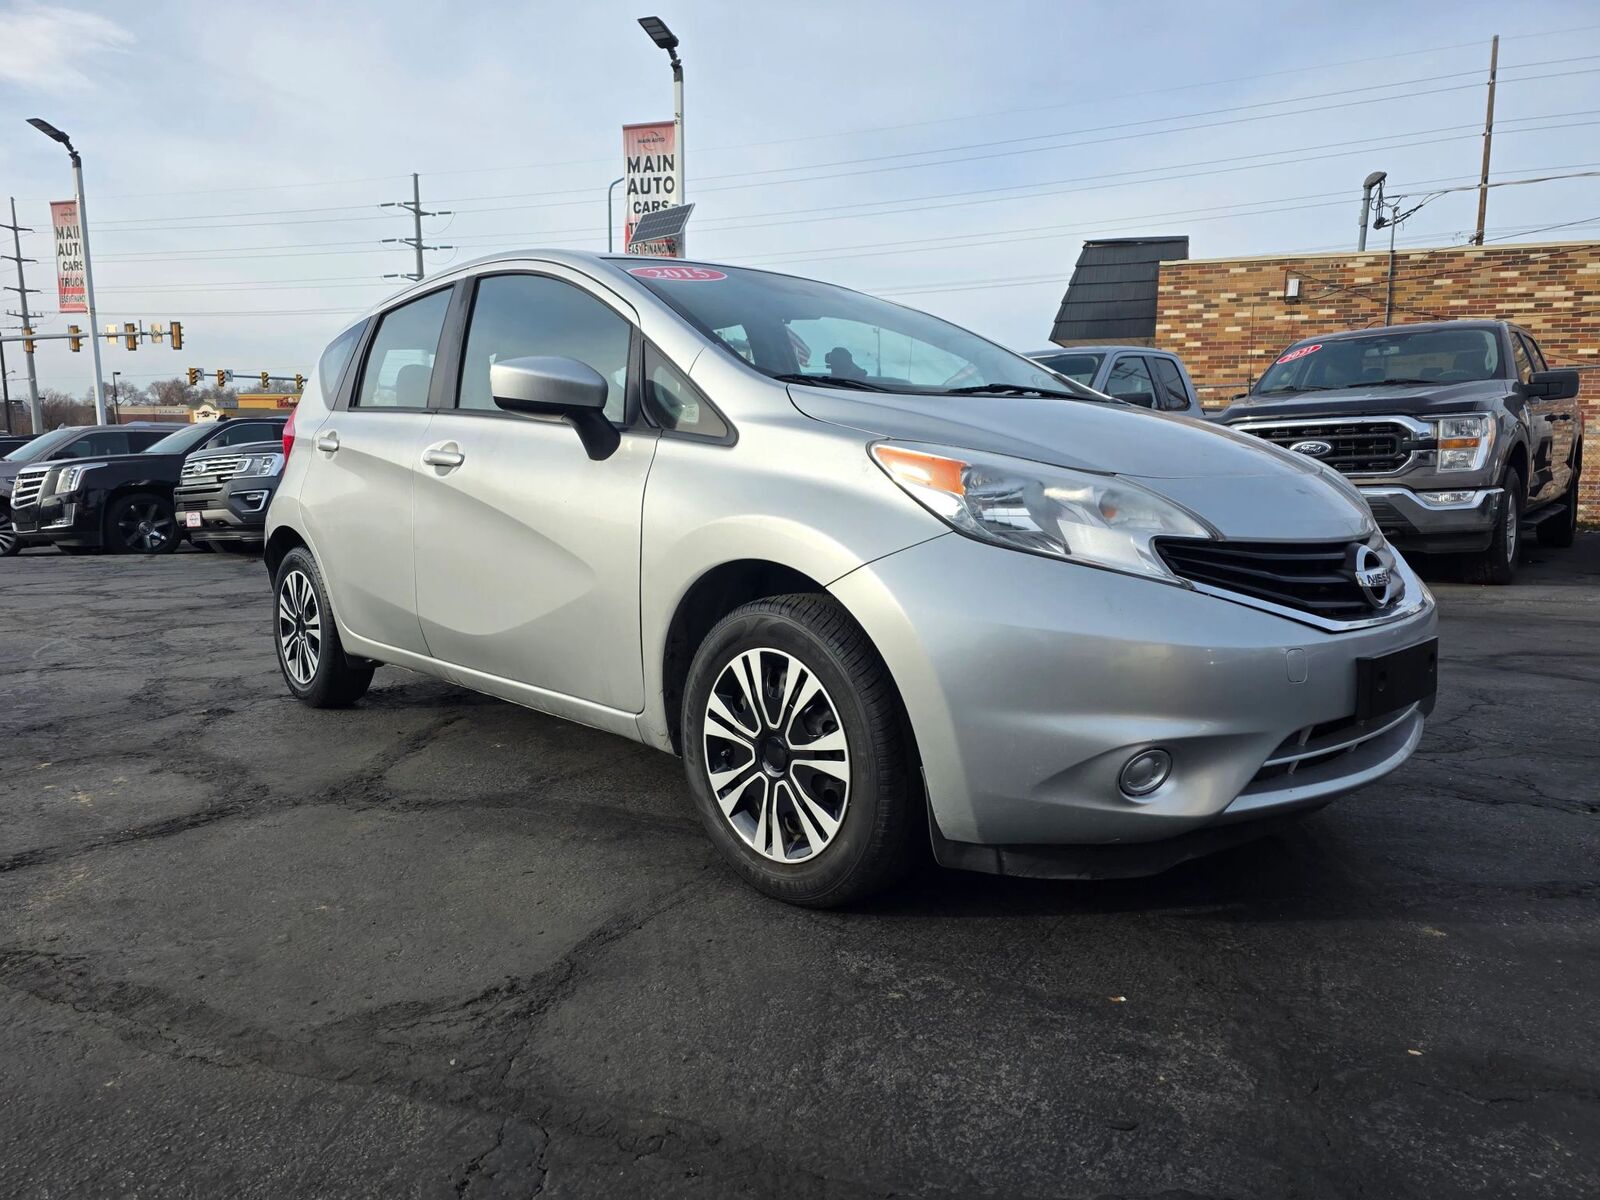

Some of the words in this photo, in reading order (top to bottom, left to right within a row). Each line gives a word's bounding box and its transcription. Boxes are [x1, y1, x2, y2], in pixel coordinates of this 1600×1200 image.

[627, 154, 674, 174] MAIN
[627, 176, 675, 196] AUTO
[58, 242, 82, 256] AUT
[628, 243, 642, 254] EASY
[648, 268, 710, 279] 2015
[1300, 444, 1322, 453] Ford
